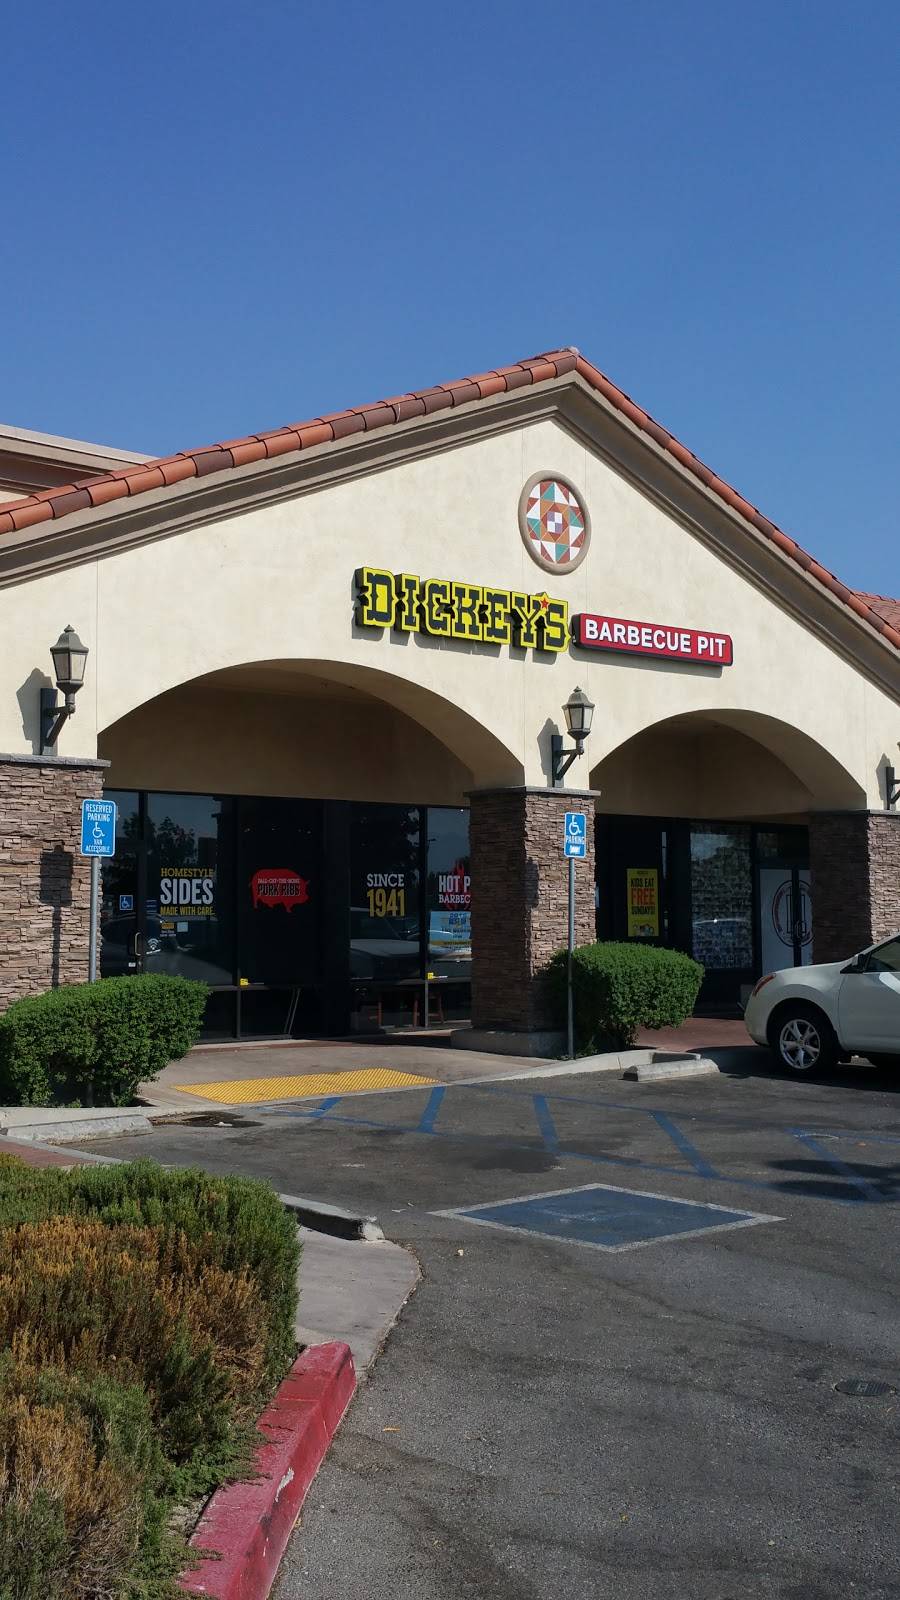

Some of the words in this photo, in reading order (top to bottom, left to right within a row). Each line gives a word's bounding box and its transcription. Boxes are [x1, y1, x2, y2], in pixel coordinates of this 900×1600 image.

[584, 618, 692, 653] BARBECUE
[697, 634, 726, 658] PIT
[85, 803, 113, 814] RESERVED
[87, 812, 111, 822] PARKING
[160, 867, 214, 877] HOMESTYLE
[366, 873, 405, 887] SINCE
[439, 875, 460, 893] HOT
[644, 877, 655, 888] EAT
[160, 878, 214, 905] SIDES
[631, 888, 656, 906] FREE
[367, 889, 405, 917] 1941
[439, 894, 471, 904] BARBEC
[160, 906, 179, 916] MADE
[180, 906, 196, 916] WITH
